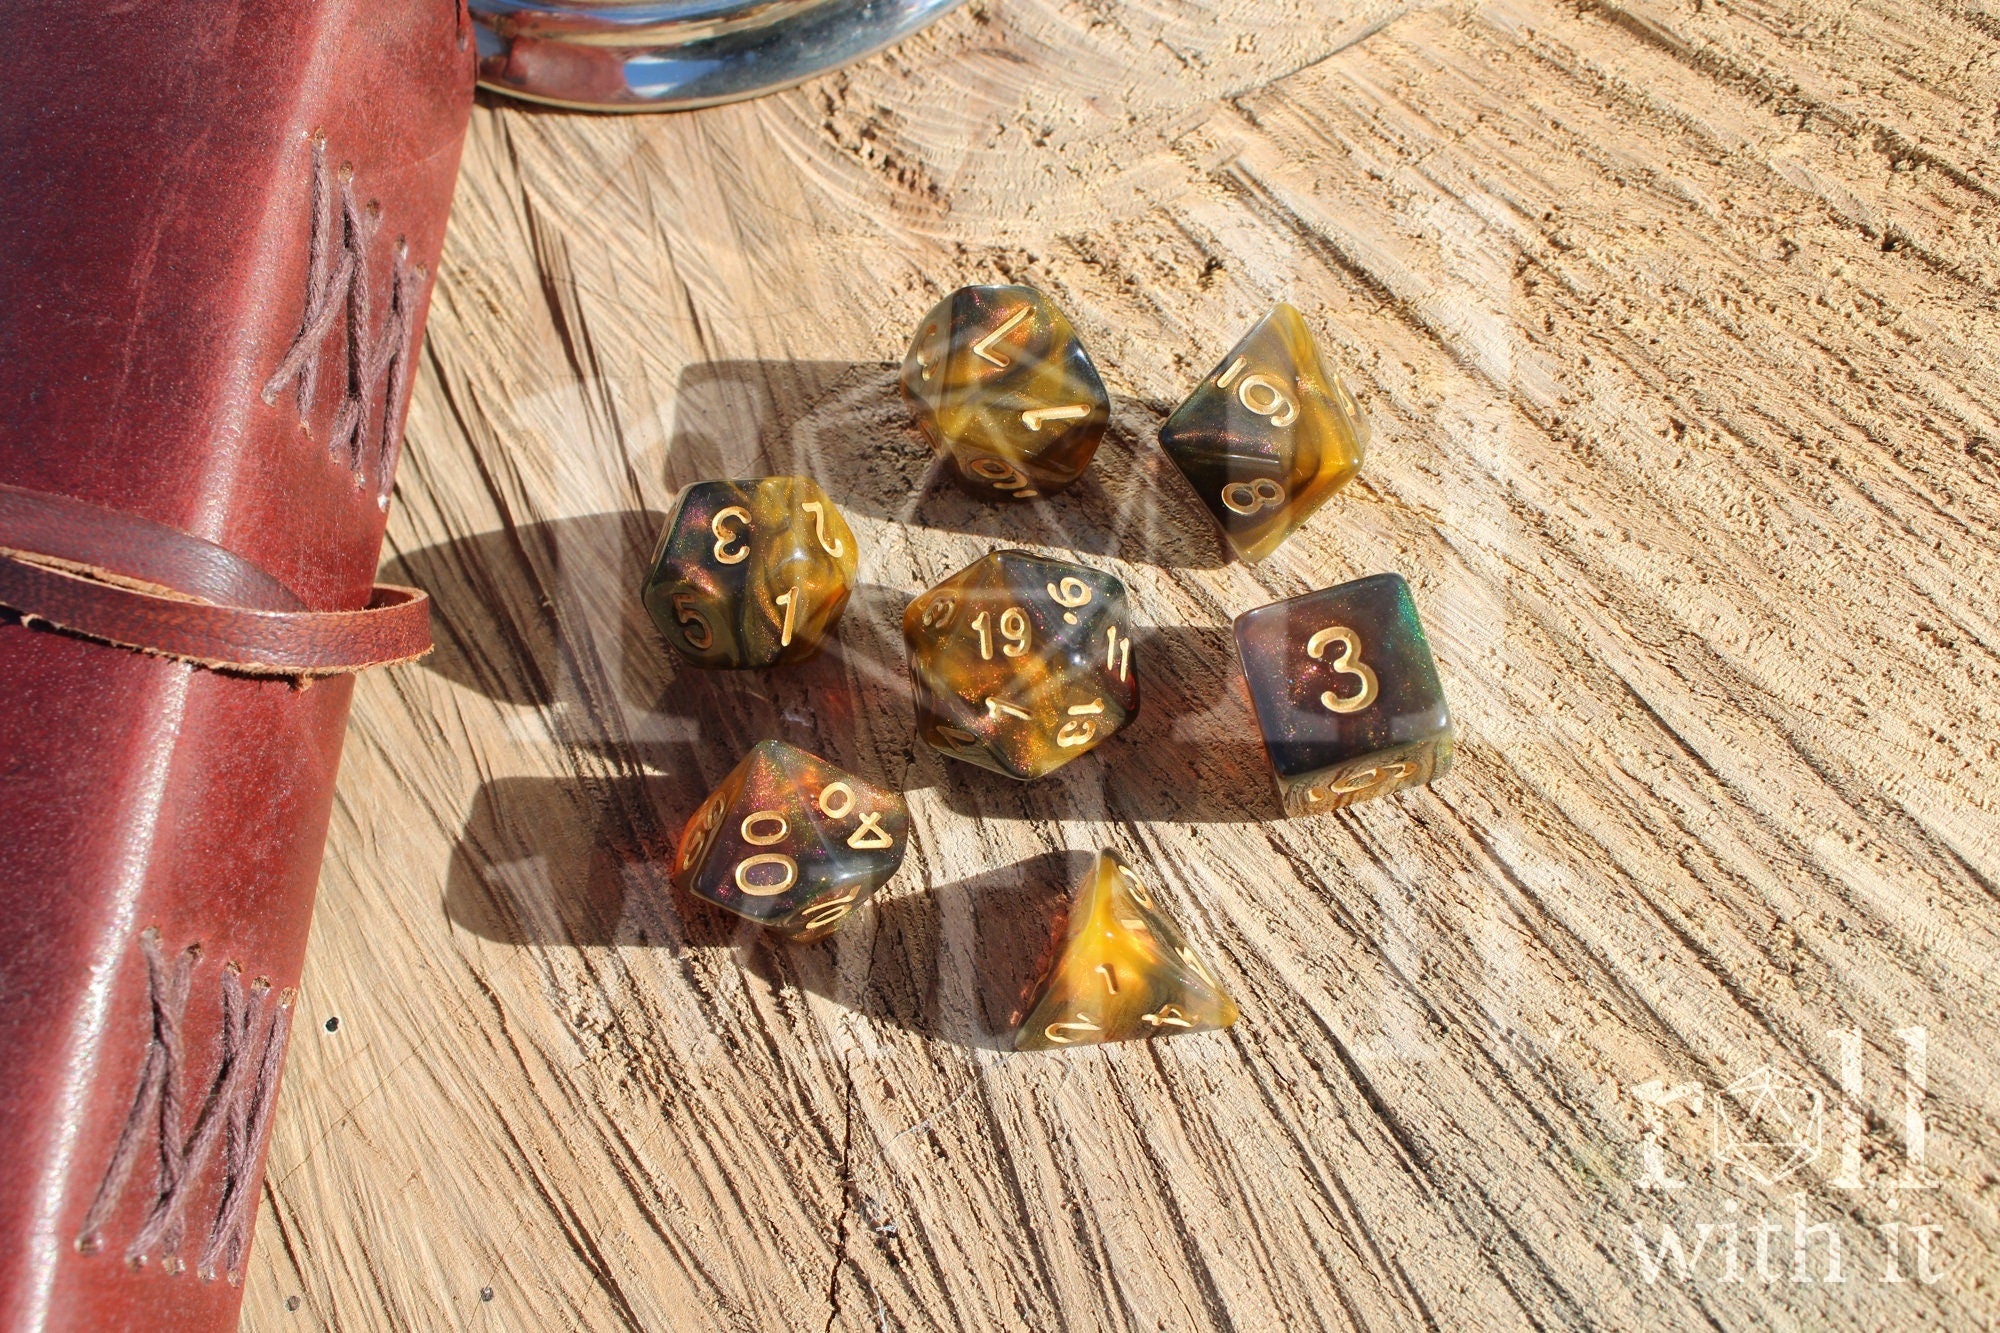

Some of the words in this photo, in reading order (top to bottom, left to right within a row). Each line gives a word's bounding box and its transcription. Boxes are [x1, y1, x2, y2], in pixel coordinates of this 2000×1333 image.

[973, 305, 1036, 368] 7
[1022, 404, 1090, 431] 1
[1221, 479, 1285, 515] 8
[711, 506, 752, 565] 3
[673, 592, 713, 651] 5
[775, 586, 799, 647] 1
[971, 606, 1032, 661] 19
[1106, 625, 1131, 682] 11
[1307, 626, 1379, 714] 3
[985, 696, 1033, 721] 1
[1056, 697, 1105, 748] 13
[735, 810, 799, 897] 00
[1094, 962, 1119, 996] 1
